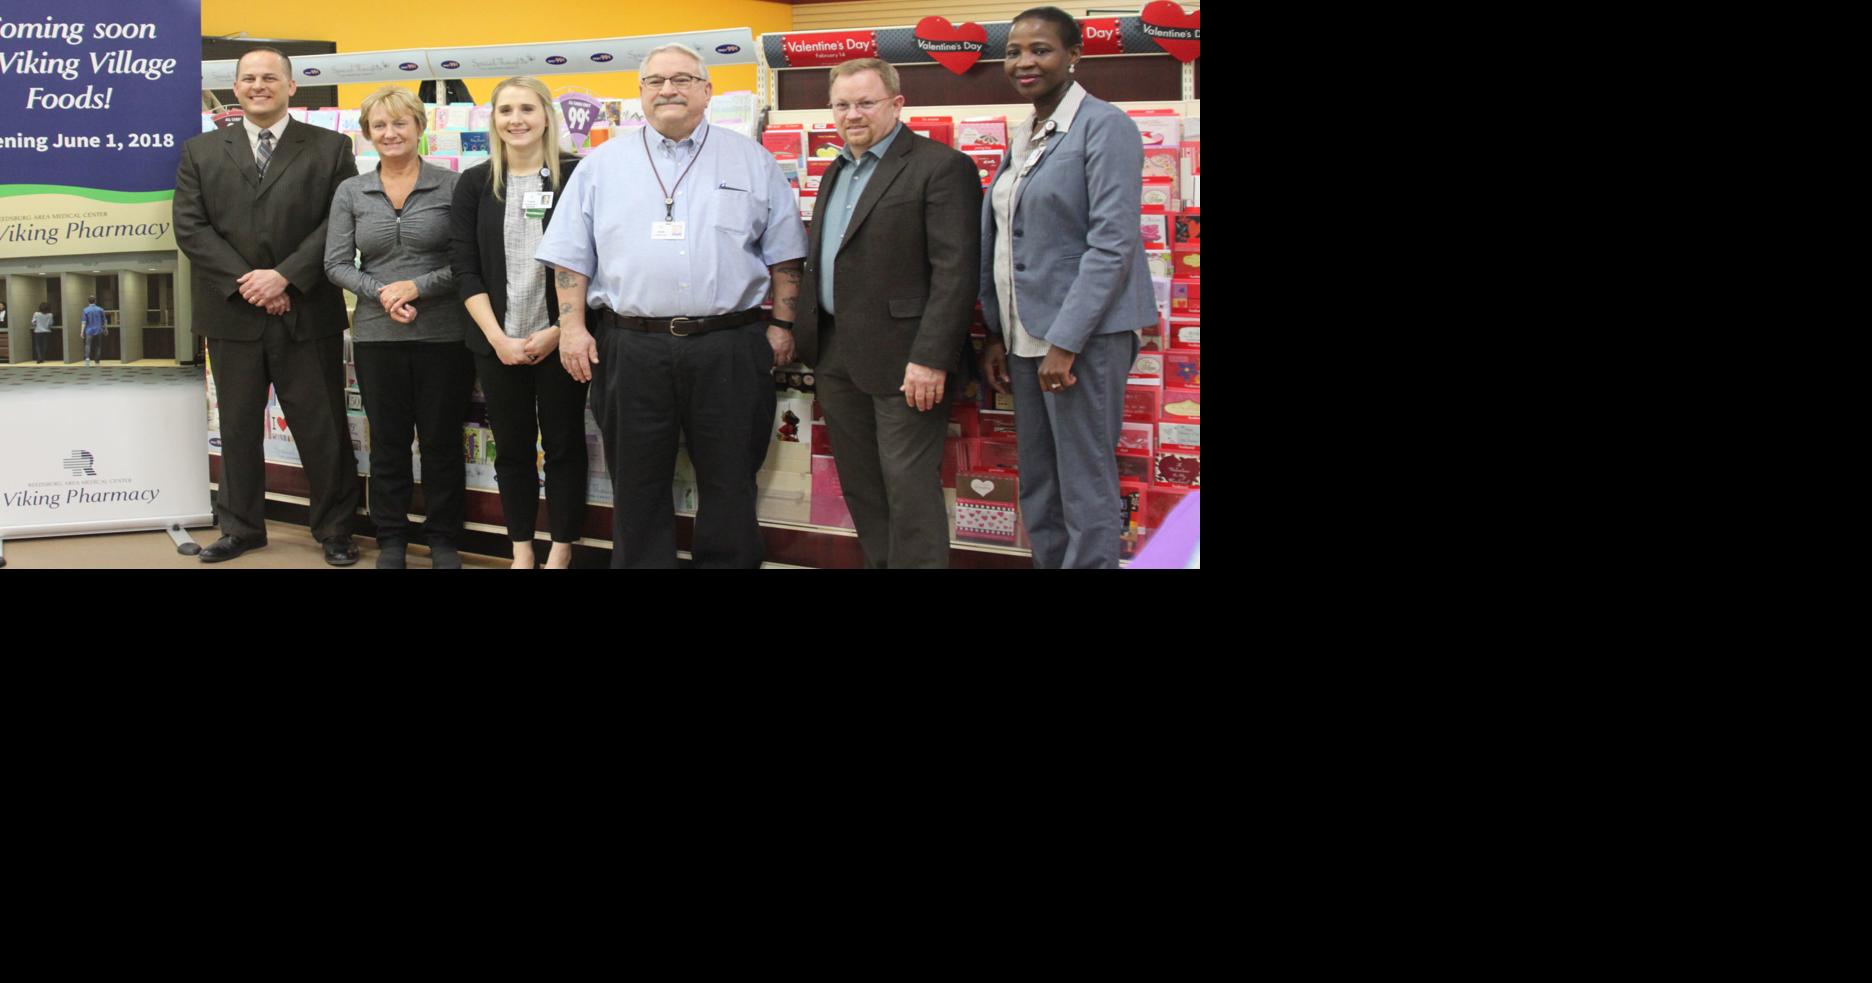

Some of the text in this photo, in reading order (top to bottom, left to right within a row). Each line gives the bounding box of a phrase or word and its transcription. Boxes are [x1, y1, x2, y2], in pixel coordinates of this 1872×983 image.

[0, 16, 157, 45] oming soon
[1086, 27, 1113, 40] Day
[1143, 24, 1192, 38] Valentine's
[787, 38, 870, 53] Valentine's Day
[917, 39, 983, 52] Valentine's Day
[0, 50, 177, 80] Viking Village
[26, 85, 113, 109] Foods!
[568, 106, 590, 130] 99¢
[52, 134, 100, 148] June
[106, 134, 124, 150] 1,
[128, 133, 175, 148] 2018
[66, 220, 170, 240] Pharmacy
[4, 487, 160, 509] Viking Pharmacy
